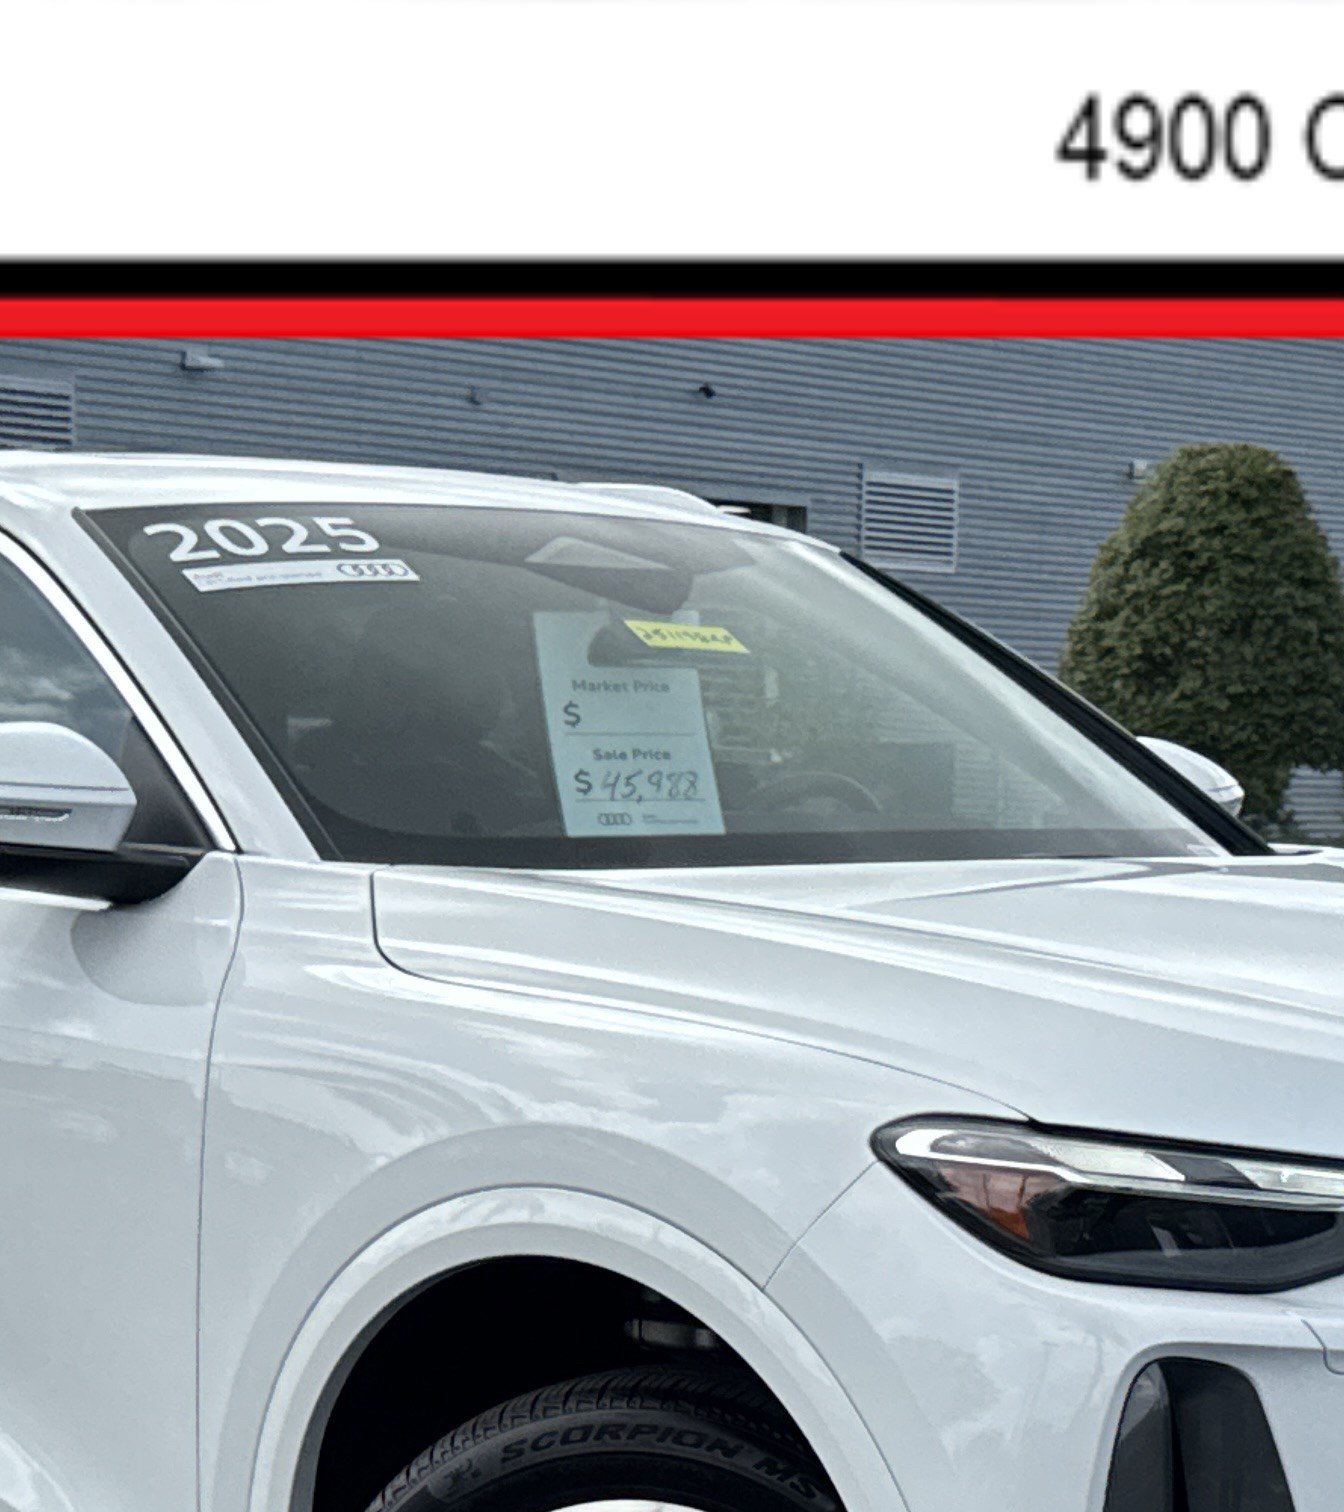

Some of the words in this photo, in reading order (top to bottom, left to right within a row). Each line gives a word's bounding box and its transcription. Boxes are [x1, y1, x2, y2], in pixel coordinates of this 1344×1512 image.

[143, 517, 380, 562] 2025
[572, 680, 628, 693] Market
[633, 680, 670, 693] Price
[563, 701, 582, 728] $
[593, 748, 628, 761] Sale
[632, 748, 672, 760] Price
[574, 768, 593, 796] $
[601, 769, 699, 804] 45,988
[500, 1423, 744, 1464] SCORPION
[752, 1457, 819, 1499] MS
